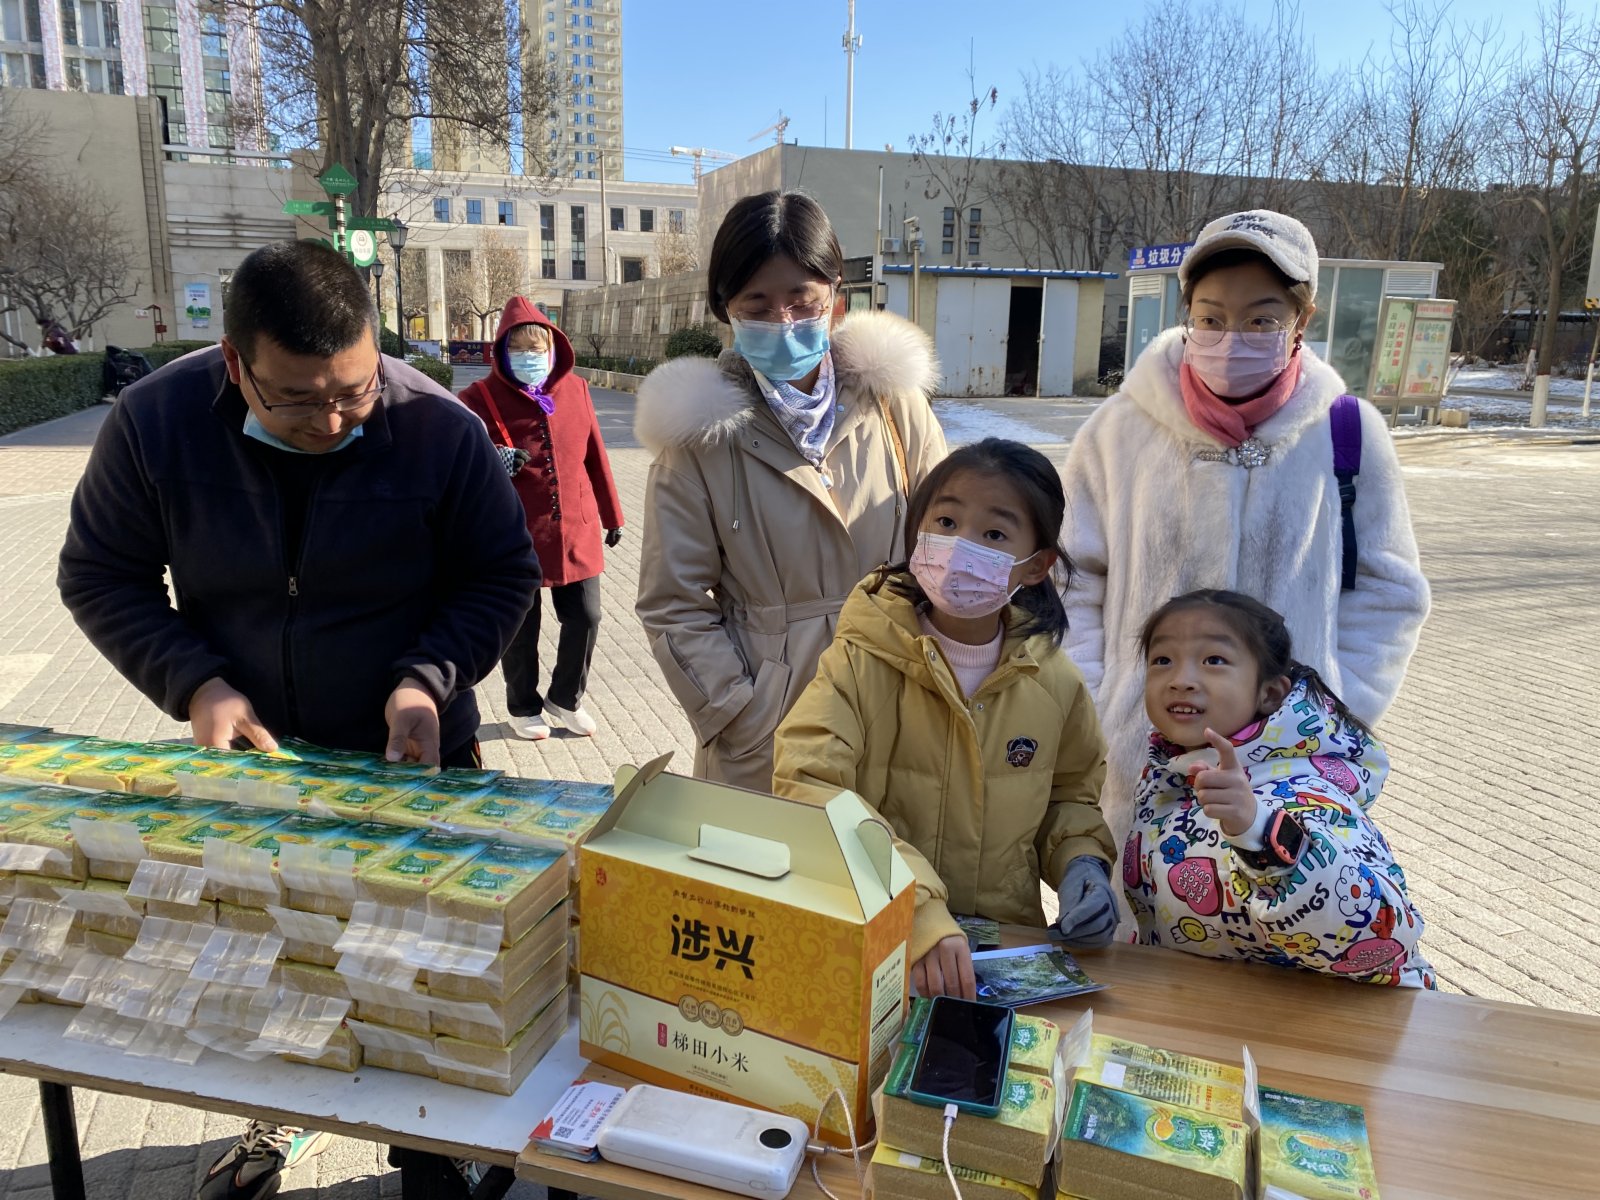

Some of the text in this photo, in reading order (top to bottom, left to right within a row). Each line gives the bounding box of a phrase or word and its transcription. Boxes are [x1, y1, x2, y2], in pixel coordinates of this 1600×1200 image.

[1258, 882, 1331, 933] THINGS
[671, 914, 755, 981] 涉兴
[672, 1030, 749, 1073] 梯田小米
